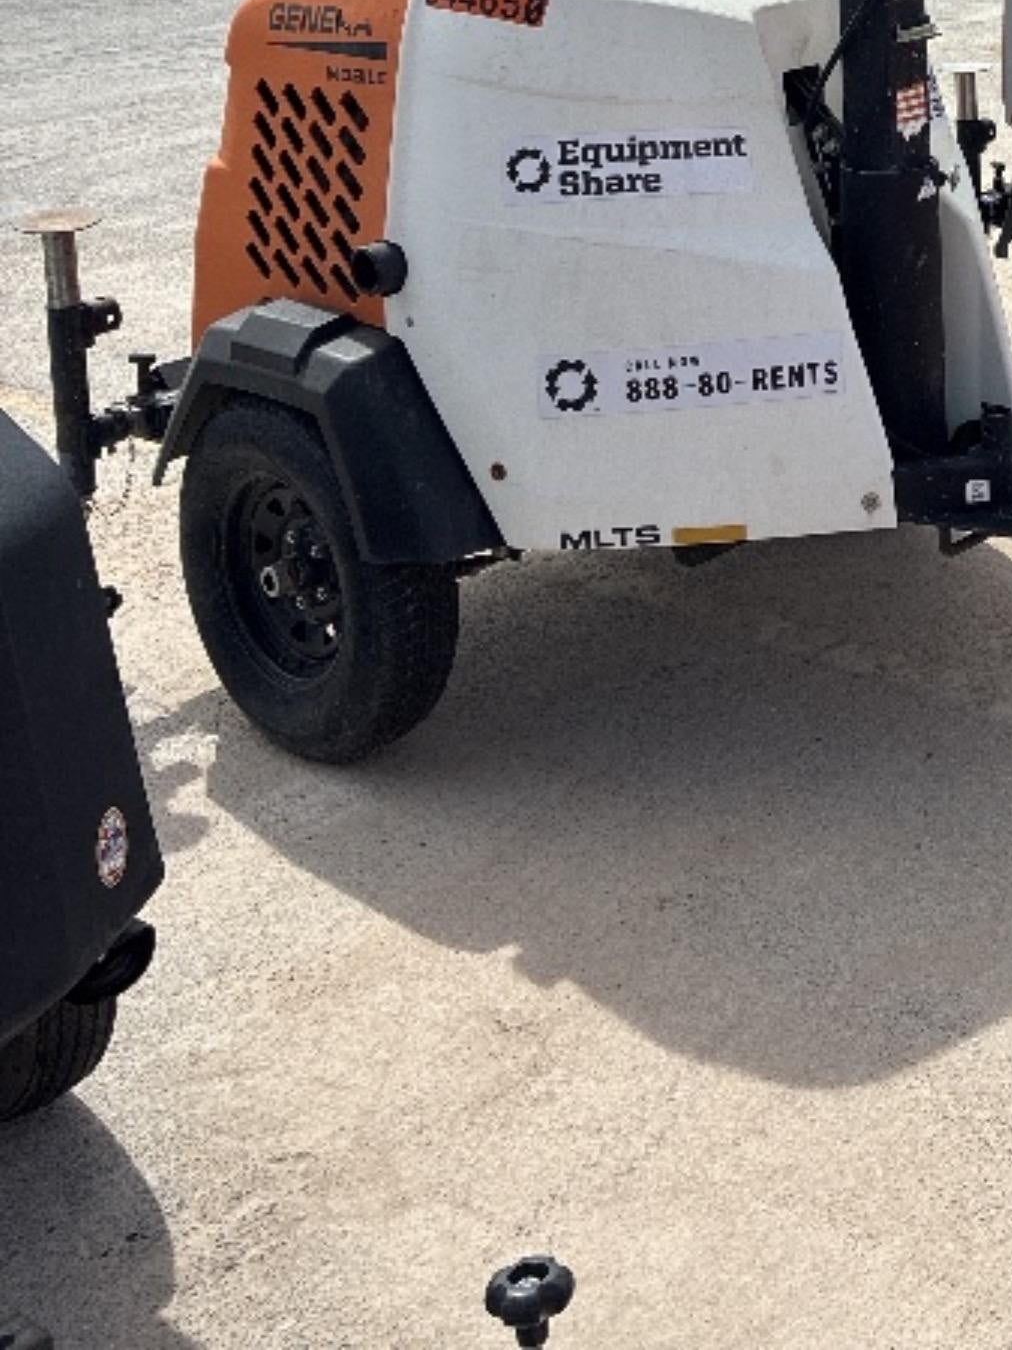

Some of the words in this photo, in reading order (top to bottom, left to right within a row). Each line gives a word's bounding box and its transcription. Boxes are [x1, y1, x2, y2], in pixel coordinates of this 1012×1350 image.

[557, 135, 747, 168] Equipment
[559, 170, 662, 196] Share
[626, 360, 838, 402] 888-80-RENTS
[560, 525, 660, 550] MLTS
